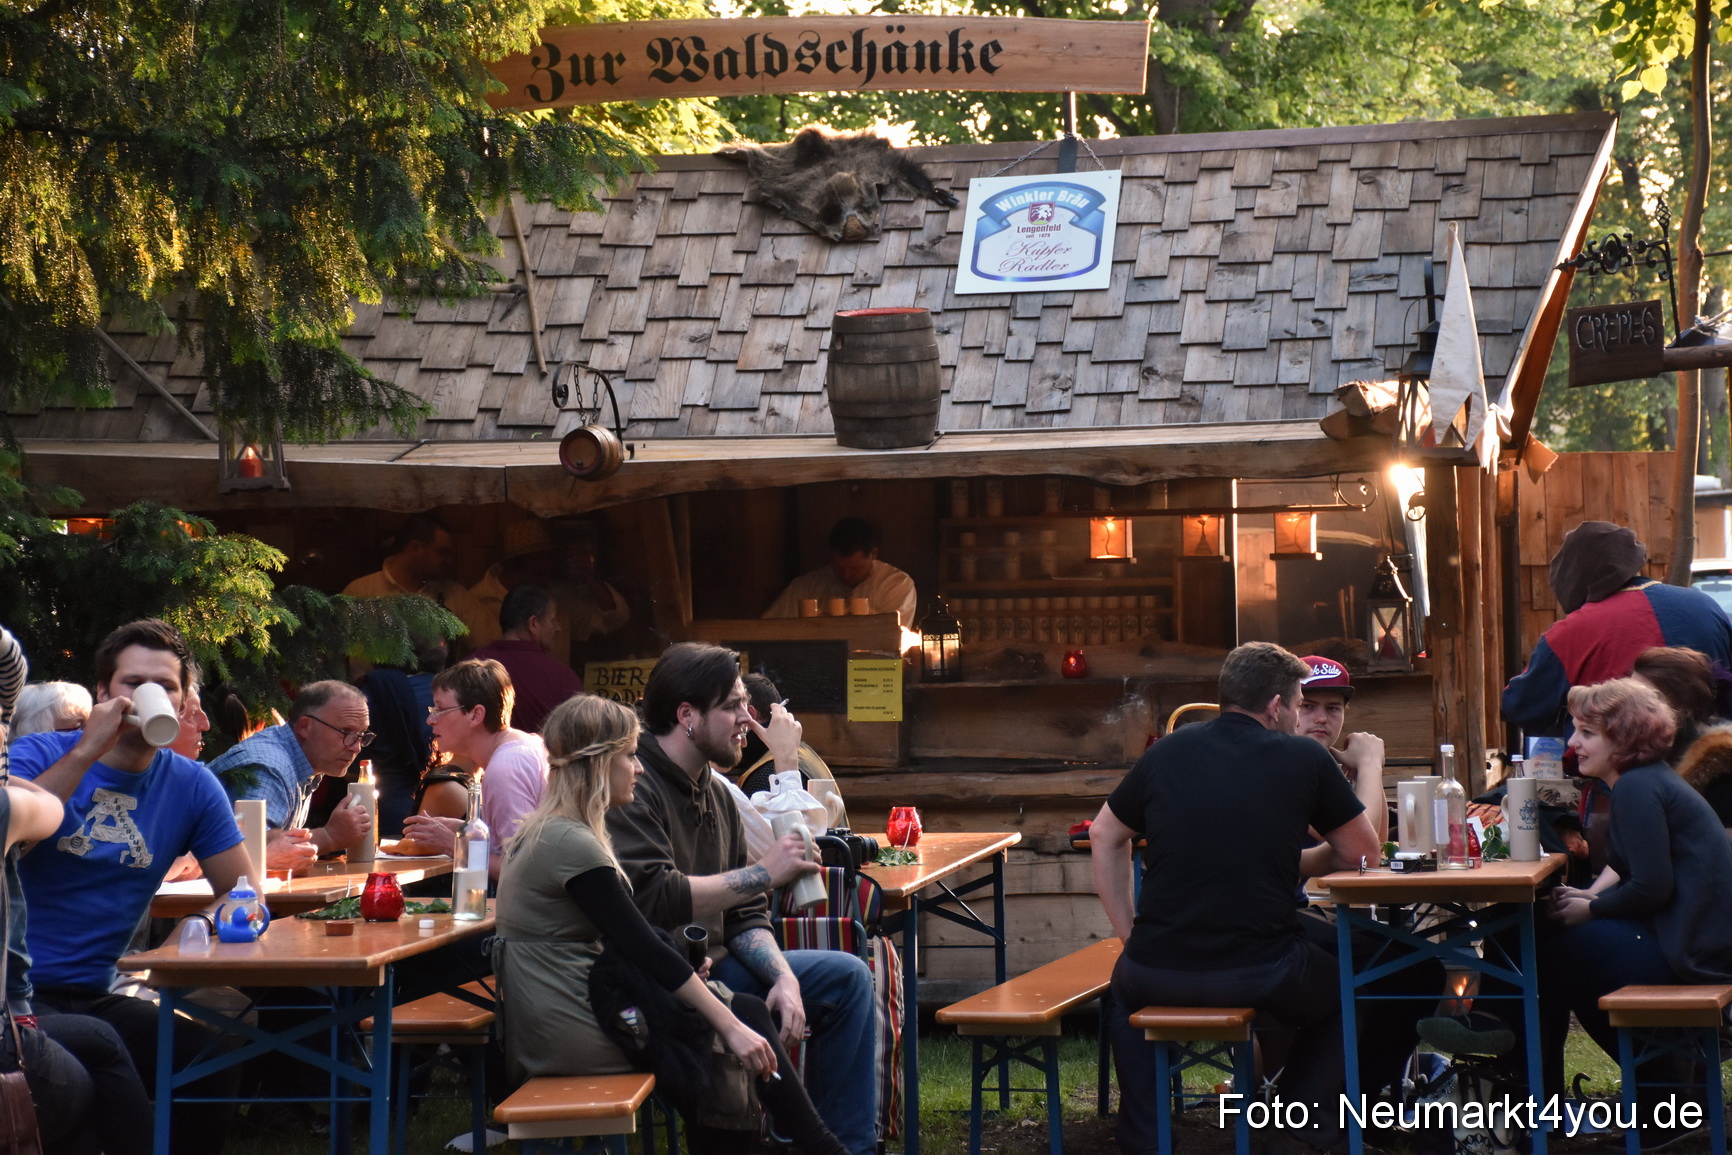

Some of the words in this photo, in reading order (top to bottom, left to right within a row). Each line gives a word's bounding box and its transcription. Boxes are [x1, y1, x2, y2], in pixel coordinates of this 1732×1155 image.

[524, 42, 626, 103] Zur
[646, 24, 1004, 88] Waldschänke
[995, 190, 1055, 212] Winkler
[1056, 189, 1090, 209] Bräu
[1016, 223, 1062, 234] Lengenfeld
[1006, 241, 1073, 261] Kupfer
[997, 257, 1070, 273] Radler
[592, 667, 646, 686] BIER
[1320, 663, 1342, 676] Side
